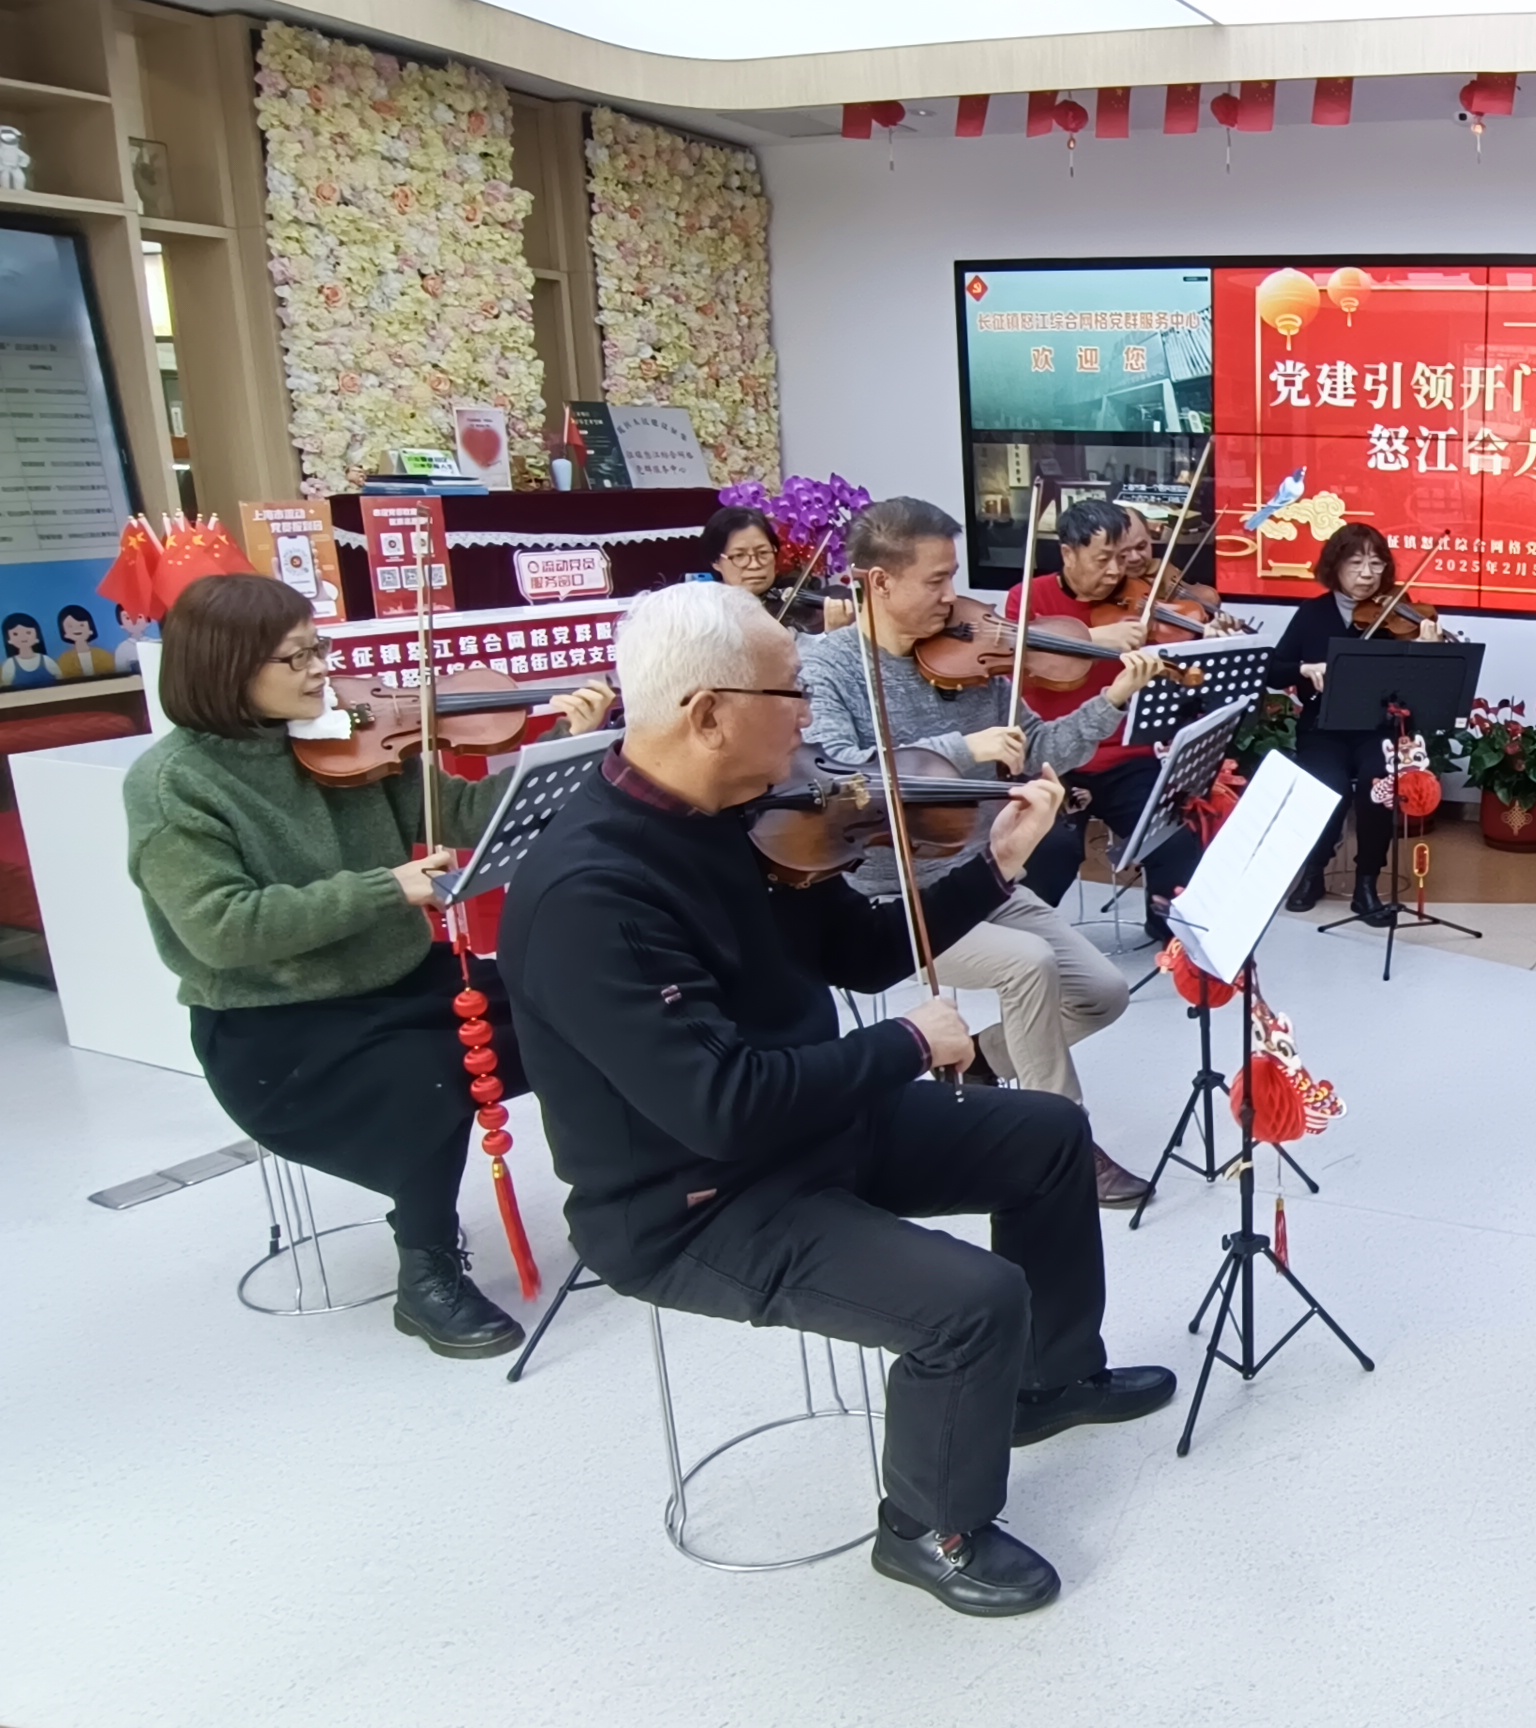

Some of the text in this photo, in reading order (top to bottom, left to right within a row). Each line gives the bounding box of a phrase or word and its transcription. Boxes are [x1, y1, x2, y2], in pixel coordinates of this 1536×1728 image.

[977, 311, 1201, 332] 长征镇怒江综合网格党群服务中心
[1031, 346, 1148, 373] 欢迎您
[541, 557, 595, 573] 流动党员
[530, 573, 584, 589] 服务窗口
